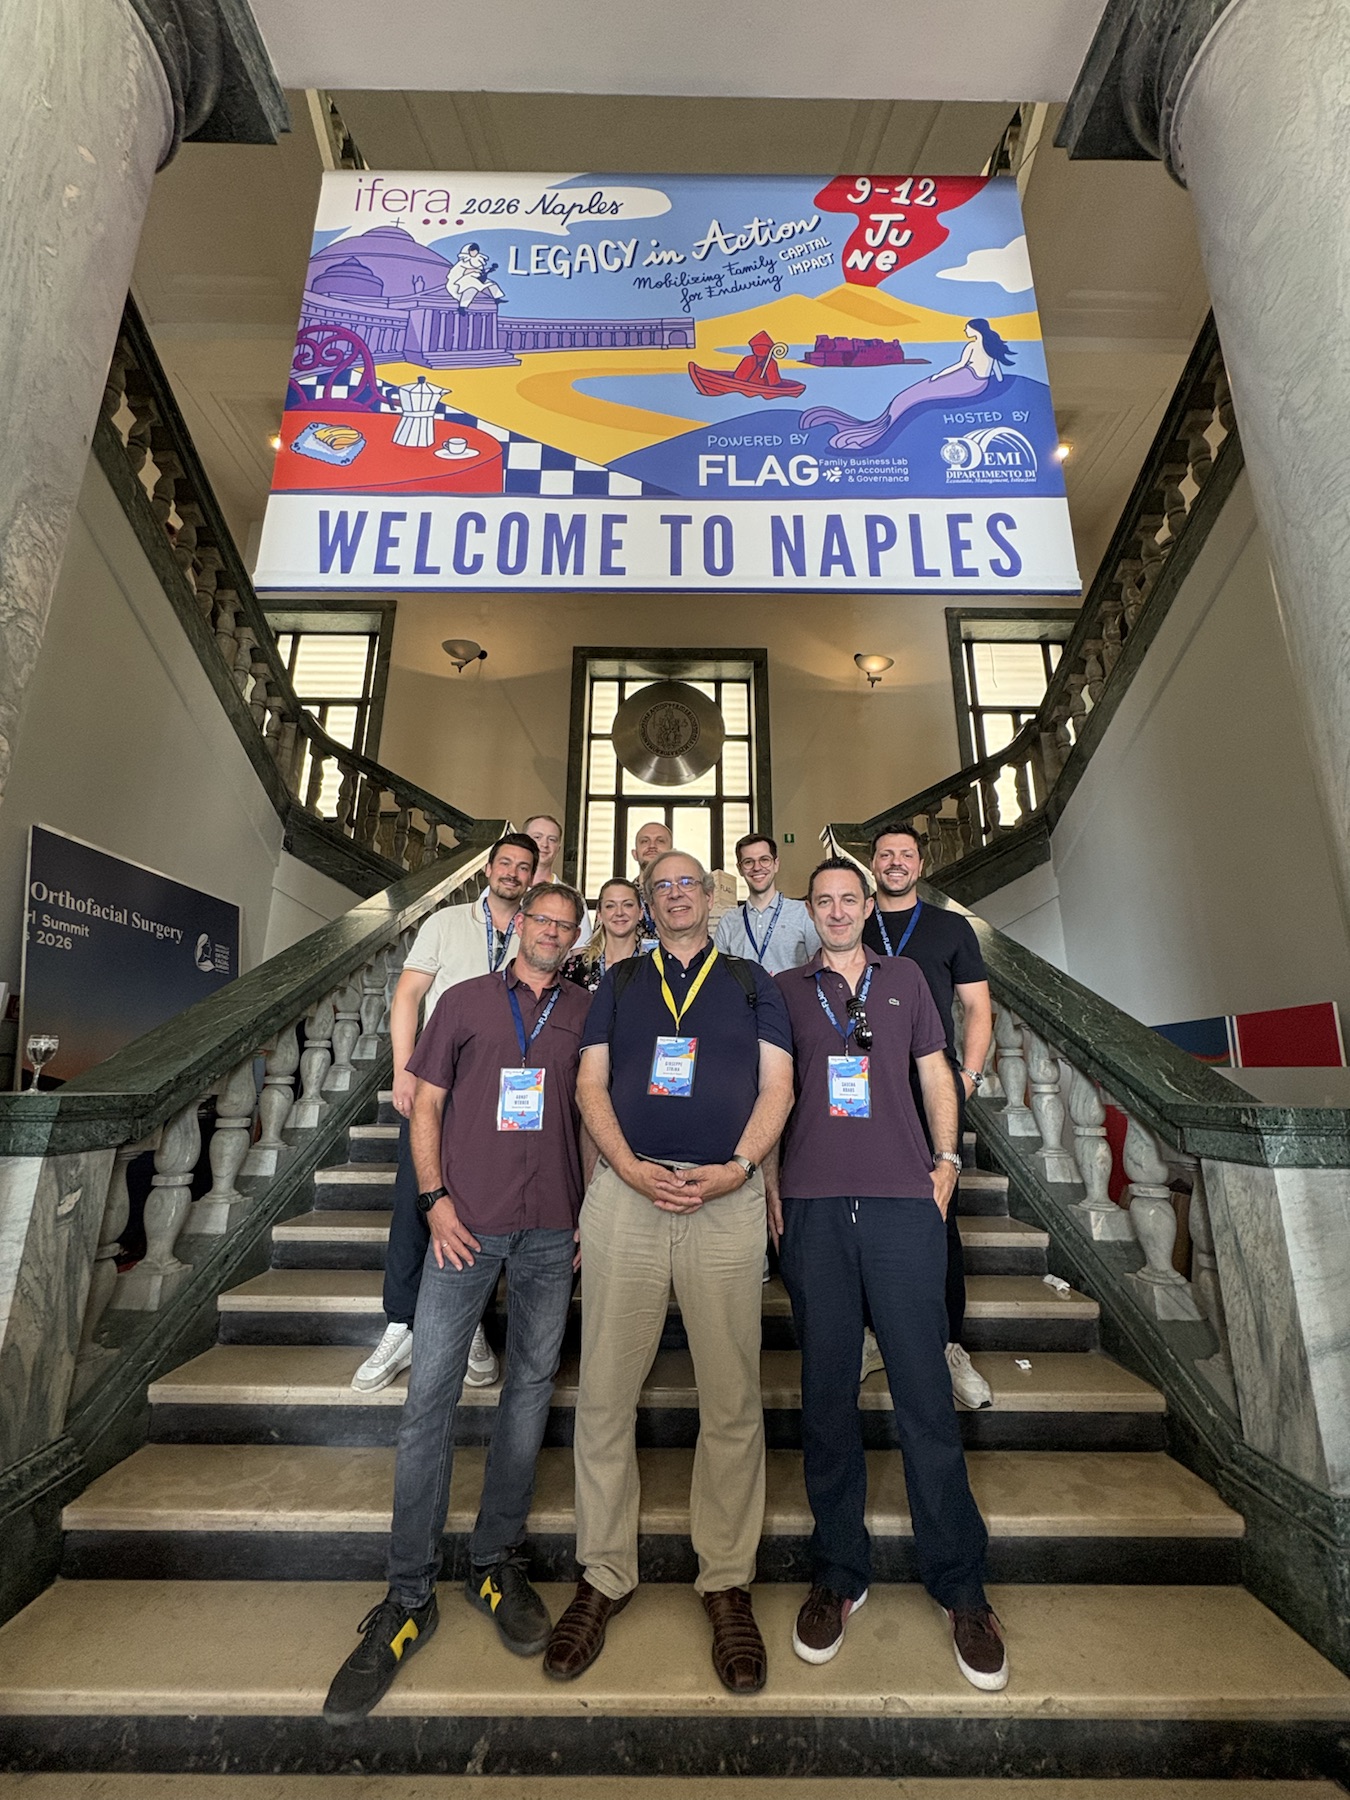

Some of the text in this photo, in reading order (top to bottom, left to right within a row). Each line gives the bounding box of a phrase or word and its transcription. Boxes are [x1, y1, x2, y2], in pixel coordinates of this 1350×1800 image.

[354, 178, 450, 214] ifera
[846, 177, 937, 207] 9-12
[460, 191, 624, 226] 2026 Naples
[865, 213, 912, 247] Ju
[507, 214, 820, 279] LEGACY in Action
[632, 236, 832, 290] Mobilizing Family CAPITAL
[680, 252, 836, 313] for Enduring IMPACT
[943, 410, 1030, 424] HOSTED BY
[706, 433, 810, 448] POWERED BY
[698, 454, 819, 487] FLAG
[818, 457, 909, 468] Family Business Lab
[844, 466, 909, 476] on Accounting
[945, 469, 1037, 479] DIPARTIMENTO DI
[847, 474, 910, 483] & Governance
[318, 510, 1023, 578] WELCOME TO NAPLES
[30, 881, 183, 944] Orthofacial Surgery
[41, 914, 90, 937] Summit
[36, 930, 73, 950] 2026
